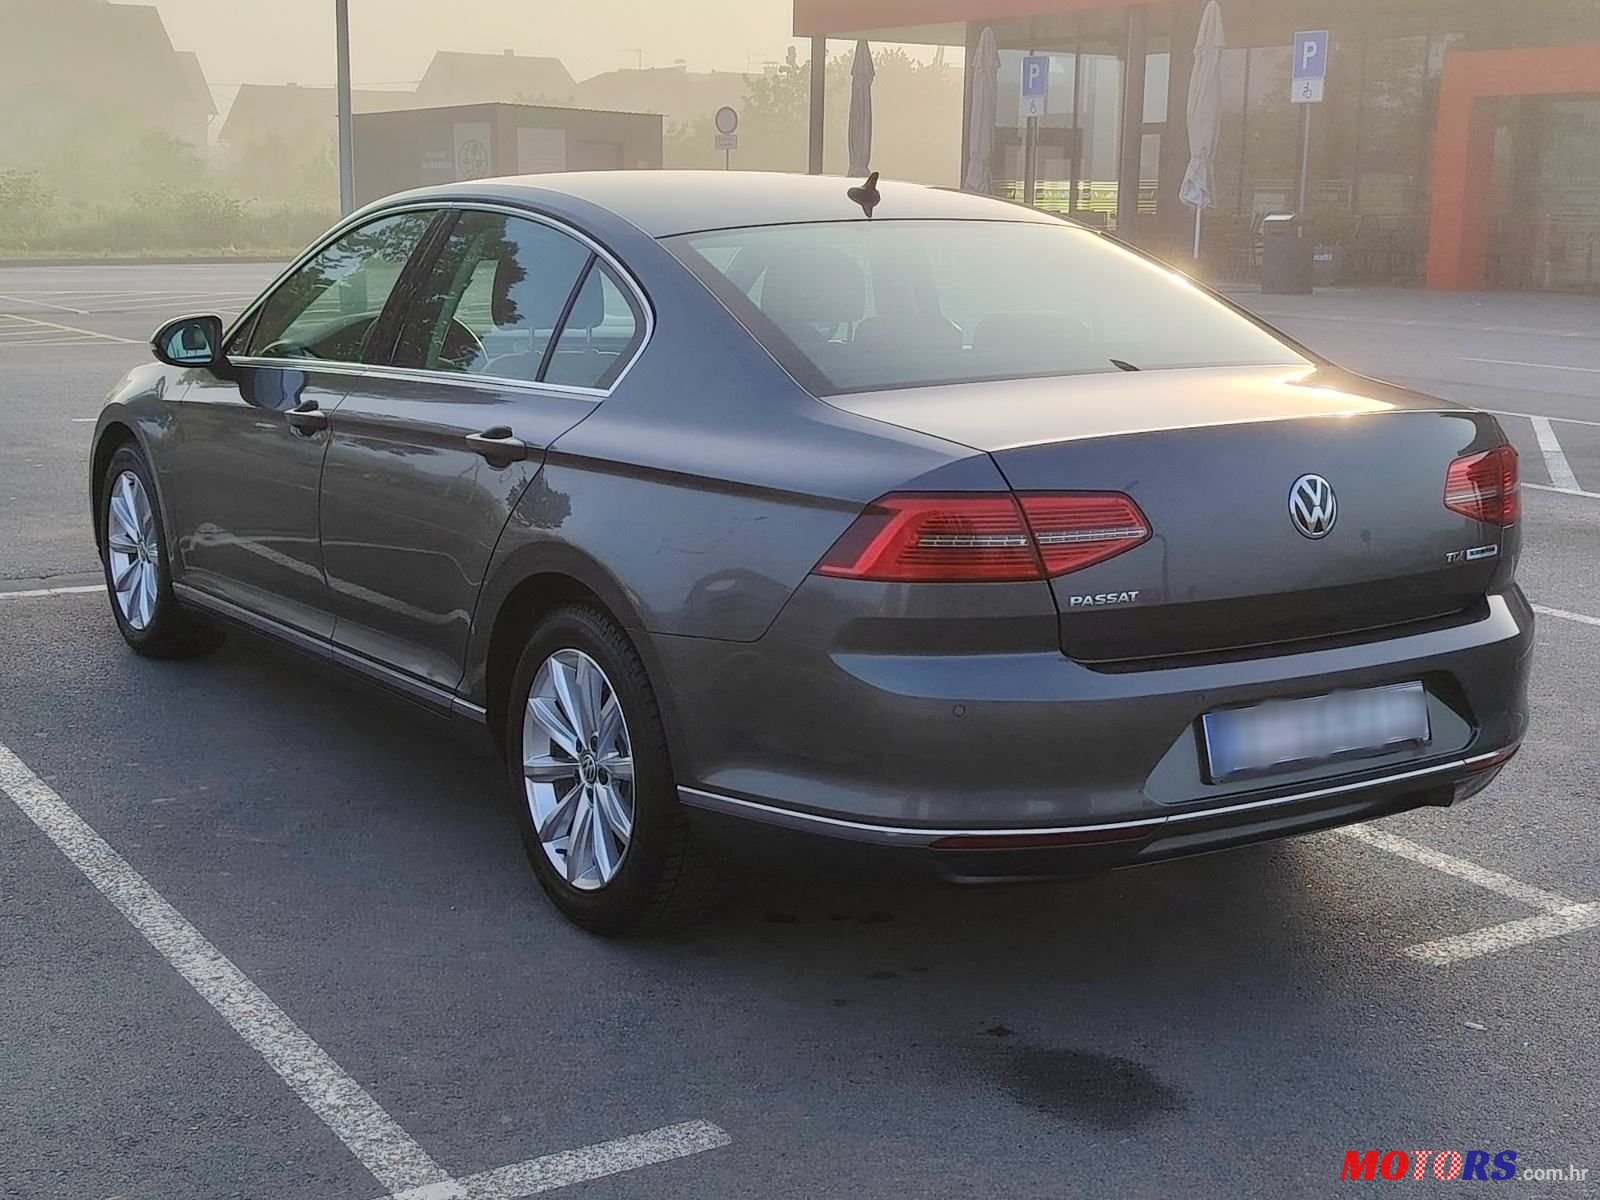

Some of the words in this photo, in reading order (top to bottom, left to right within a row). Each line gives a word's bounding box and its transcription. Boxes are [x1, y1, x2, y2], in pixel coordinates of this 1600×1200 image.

[1303, 40, 1318, 70] P
[1029, 63, 1040, 89] P
[1289, 474, 1337, 538] VW
[1069, 590, 1139, 607] PASSAT
